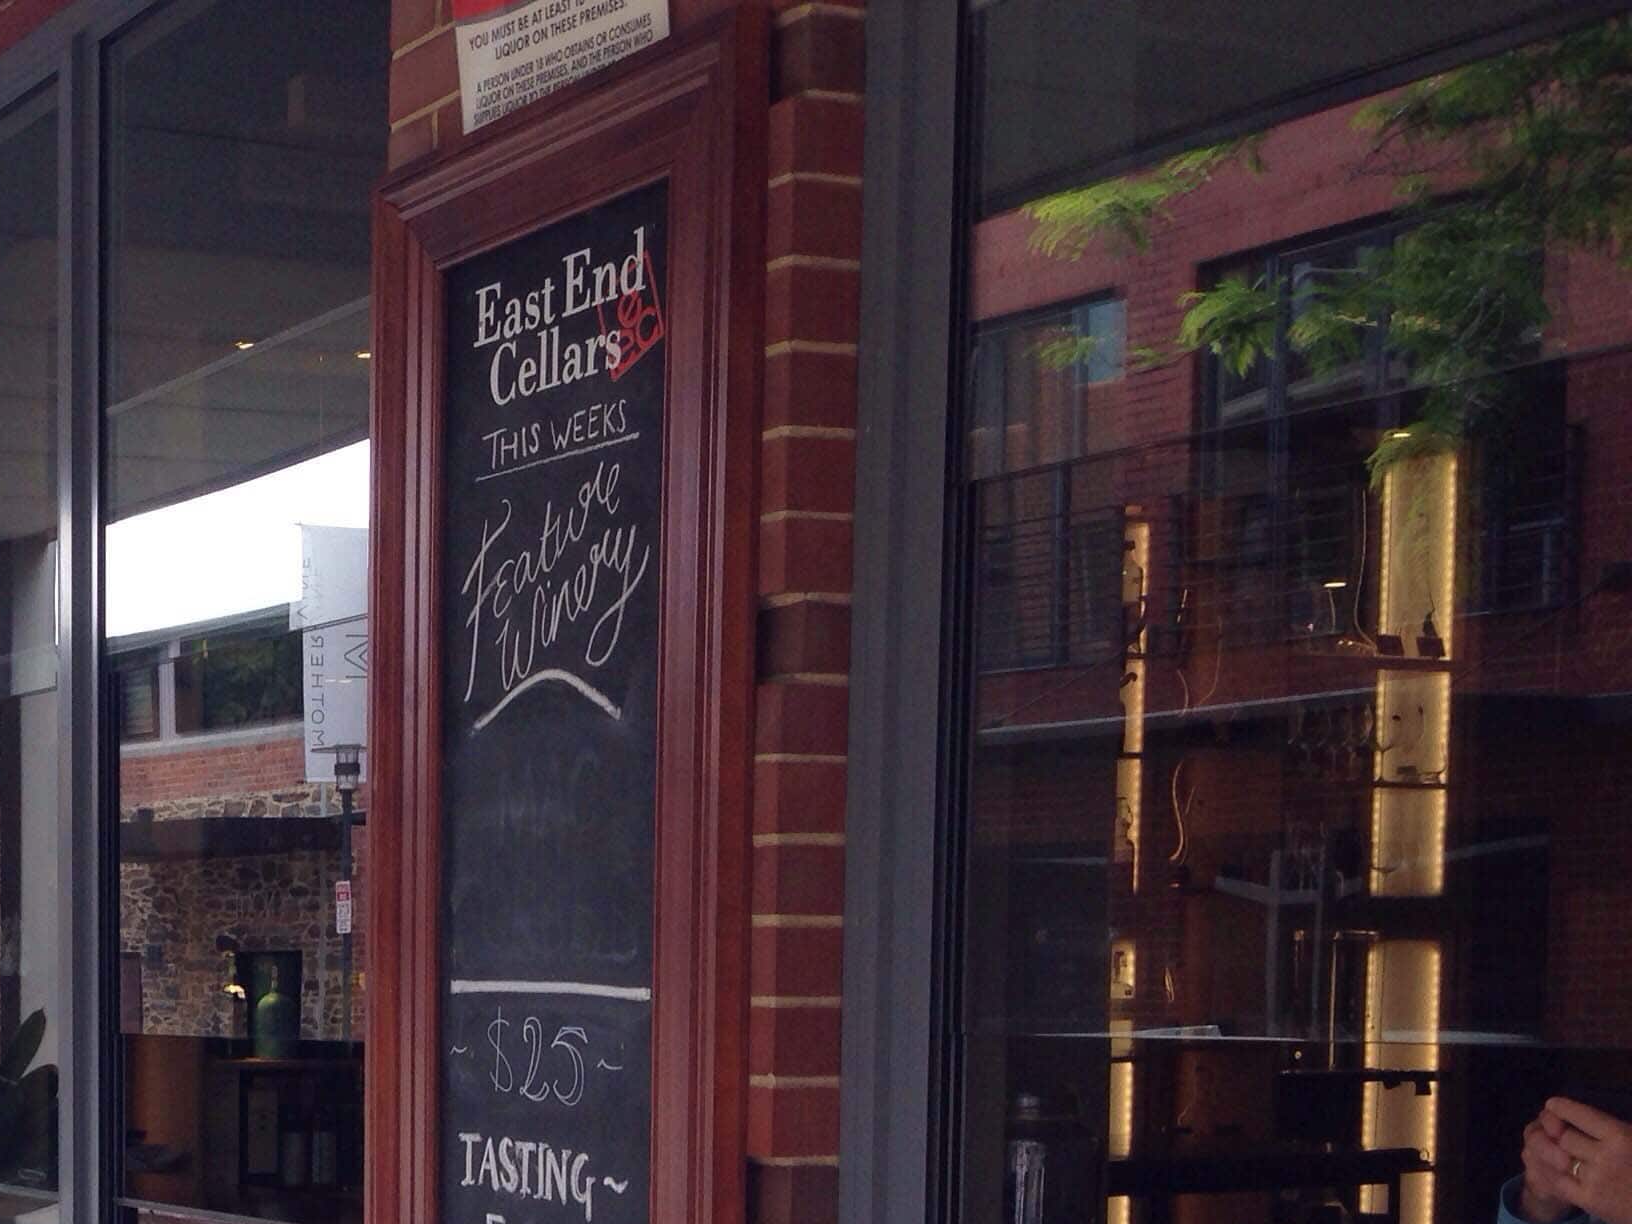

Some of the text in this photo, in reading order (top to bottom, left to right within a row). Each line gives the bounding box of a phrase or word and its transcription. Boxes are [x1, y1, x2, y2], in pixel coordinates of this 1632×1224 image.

[469, 0, 571, 51] YOU MUST BE AT LEAST
[483, 71, 510, 92] PERSON
[511, 61, 534, 82] UNDER
[544, 49, 563, 68] WHO
[596, 31, 607, 47] OR
[608, 12, 653, 41] CONSUMES
[495, 34, 530, 60] LIQUOR
[532, 26, 548, 44] ON
[550, 14, 577, 38] THESE
[502, 83, 515, 100] ON
[571, 55, 588, 73] AND
[603, 38, 633, 60] PERSON
[633, 28, 654, 47] WHO
[473, 226, 646, 348] East End
[489, 329, 622, 406] Cellars
[482, 399, 627, 469] THIS WEEKS
[461, 460, 620, 702] Feature
[495, 524, 651, 691] Winery
[486, 1005, 589, 1106] $25
